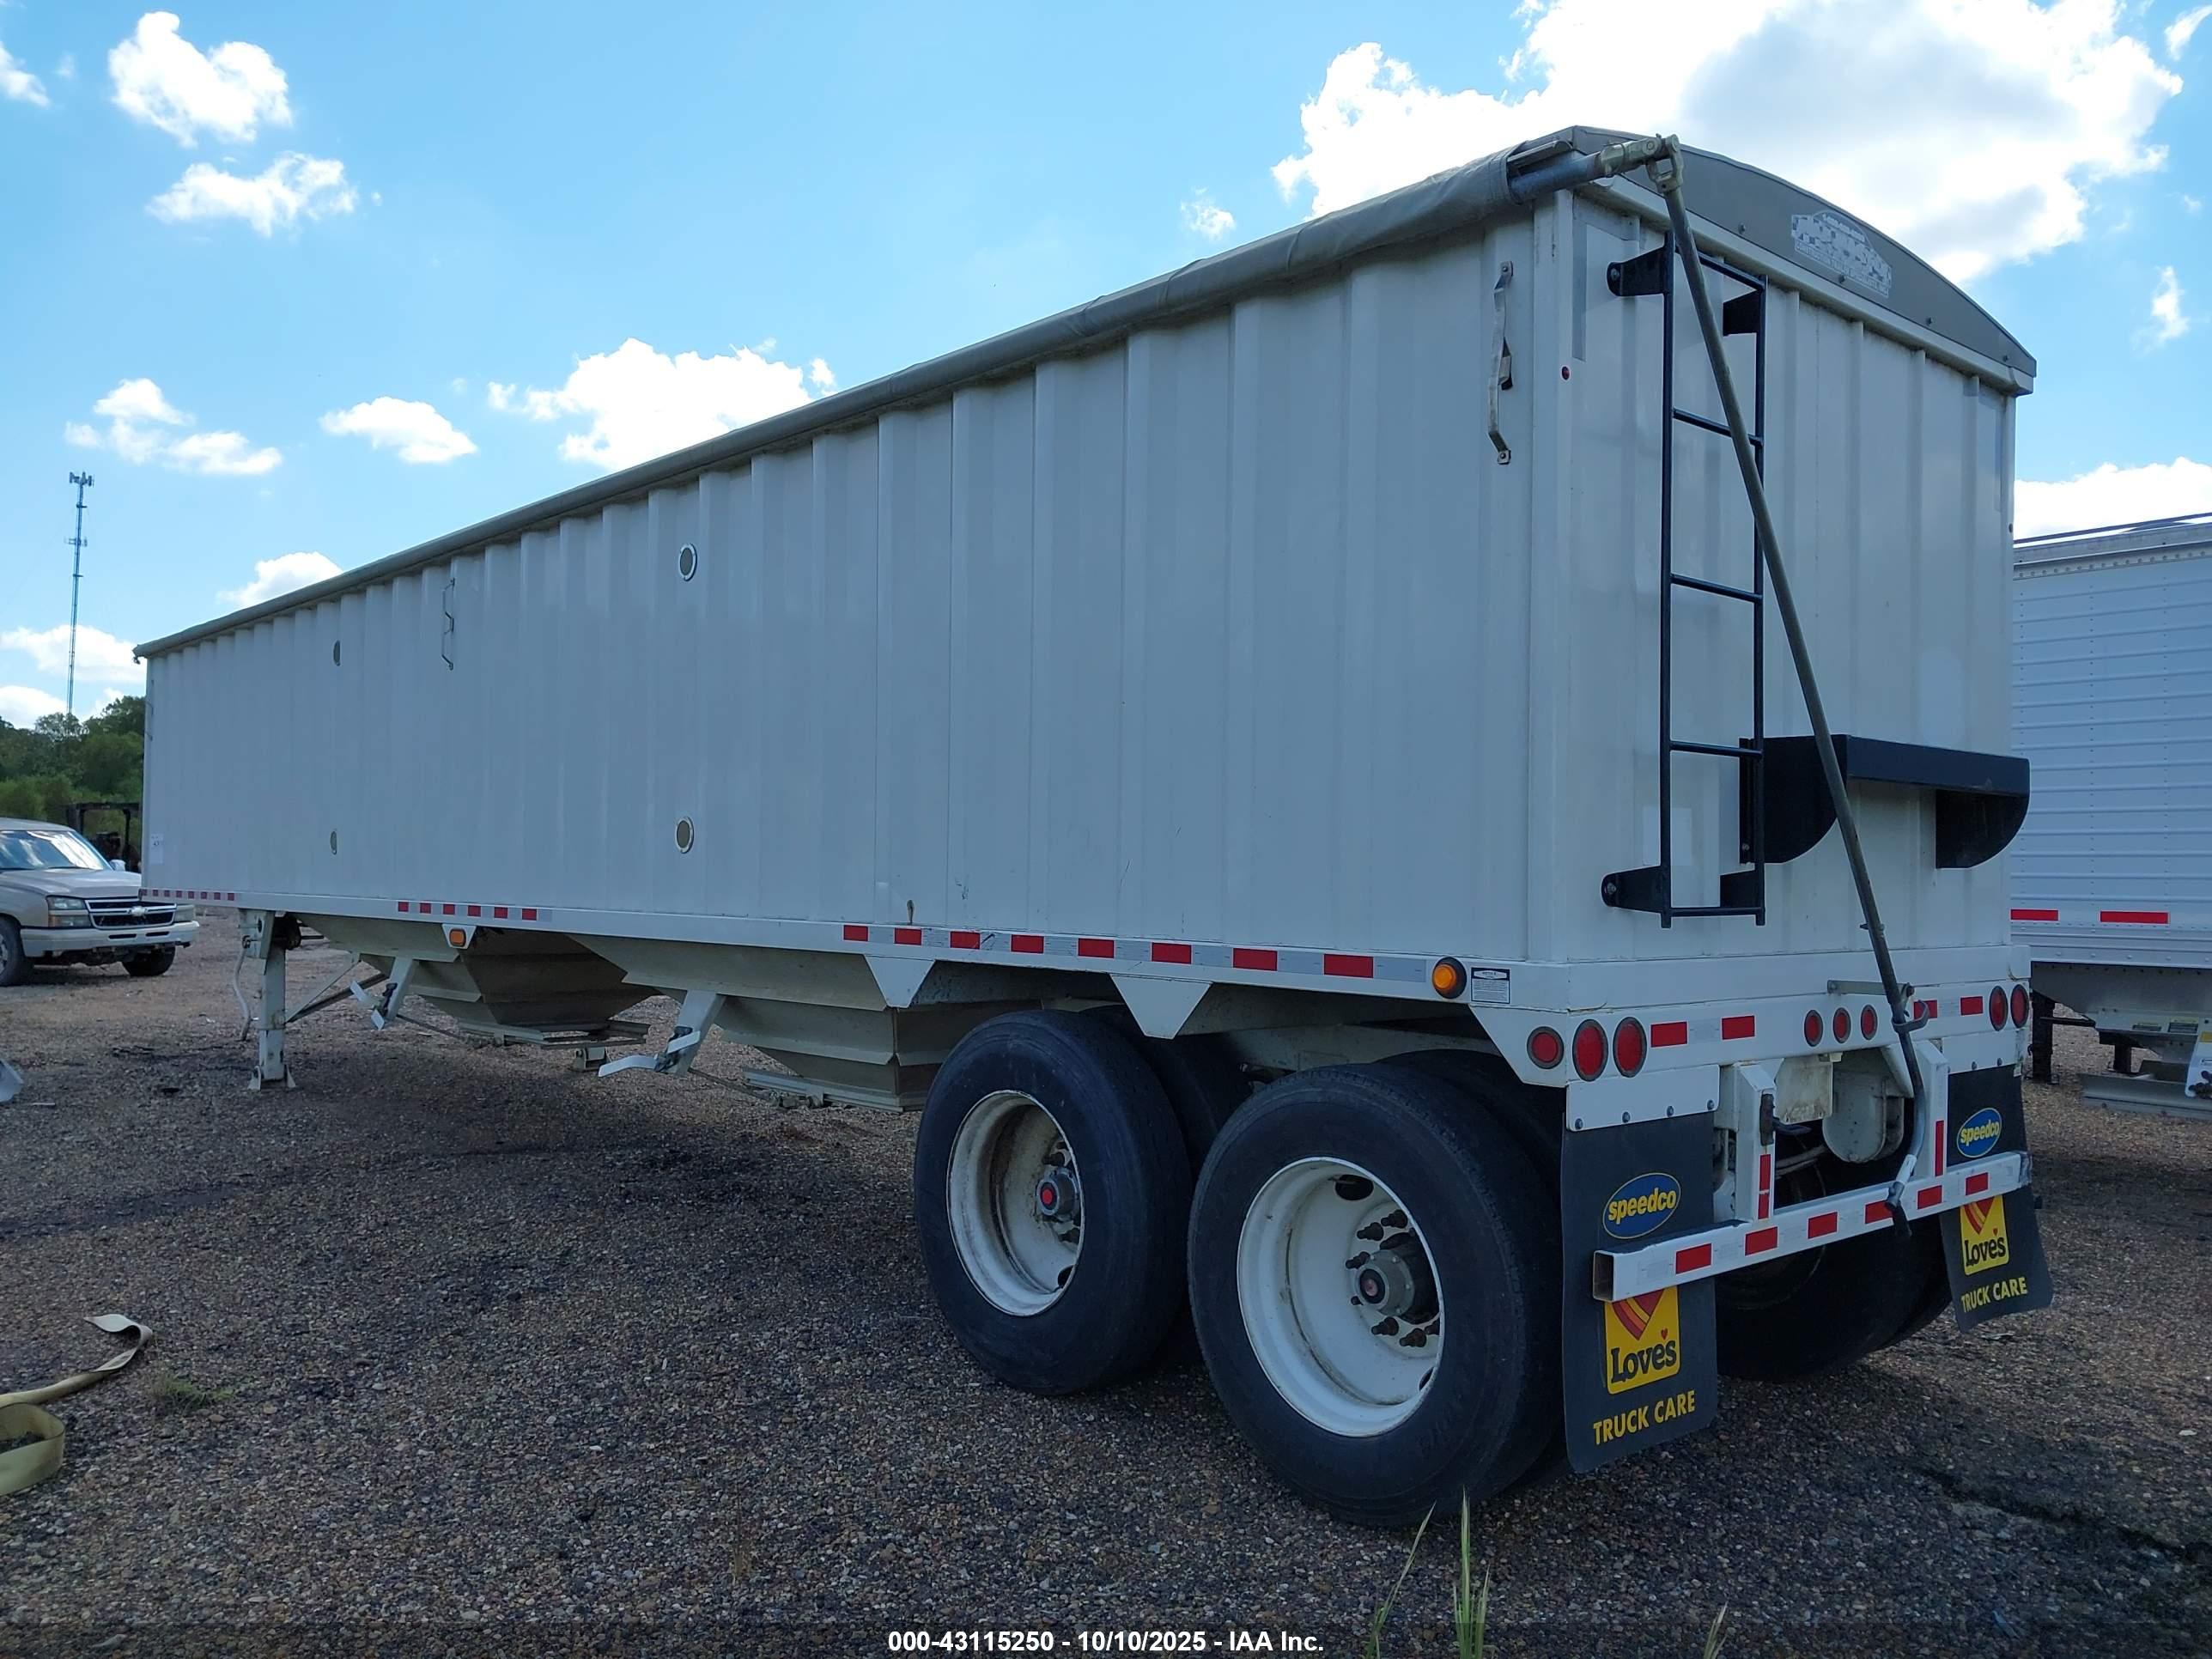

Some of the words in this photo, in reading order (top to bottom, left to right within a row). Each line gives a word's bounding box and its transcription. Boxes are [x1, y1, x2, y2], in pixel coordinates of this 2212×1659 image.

[1960, 1120, 2000, 1146] speedco
[1607, 1188, 1676, 1224] speedco
[1961, 1282, 1991, 1313] TRUCK
[1993, 1276, 2028, 1302] CARE
[1593, 1406, 1650, 1445] TRUCK
[1654, 1389, 1696, 1425] CARE
